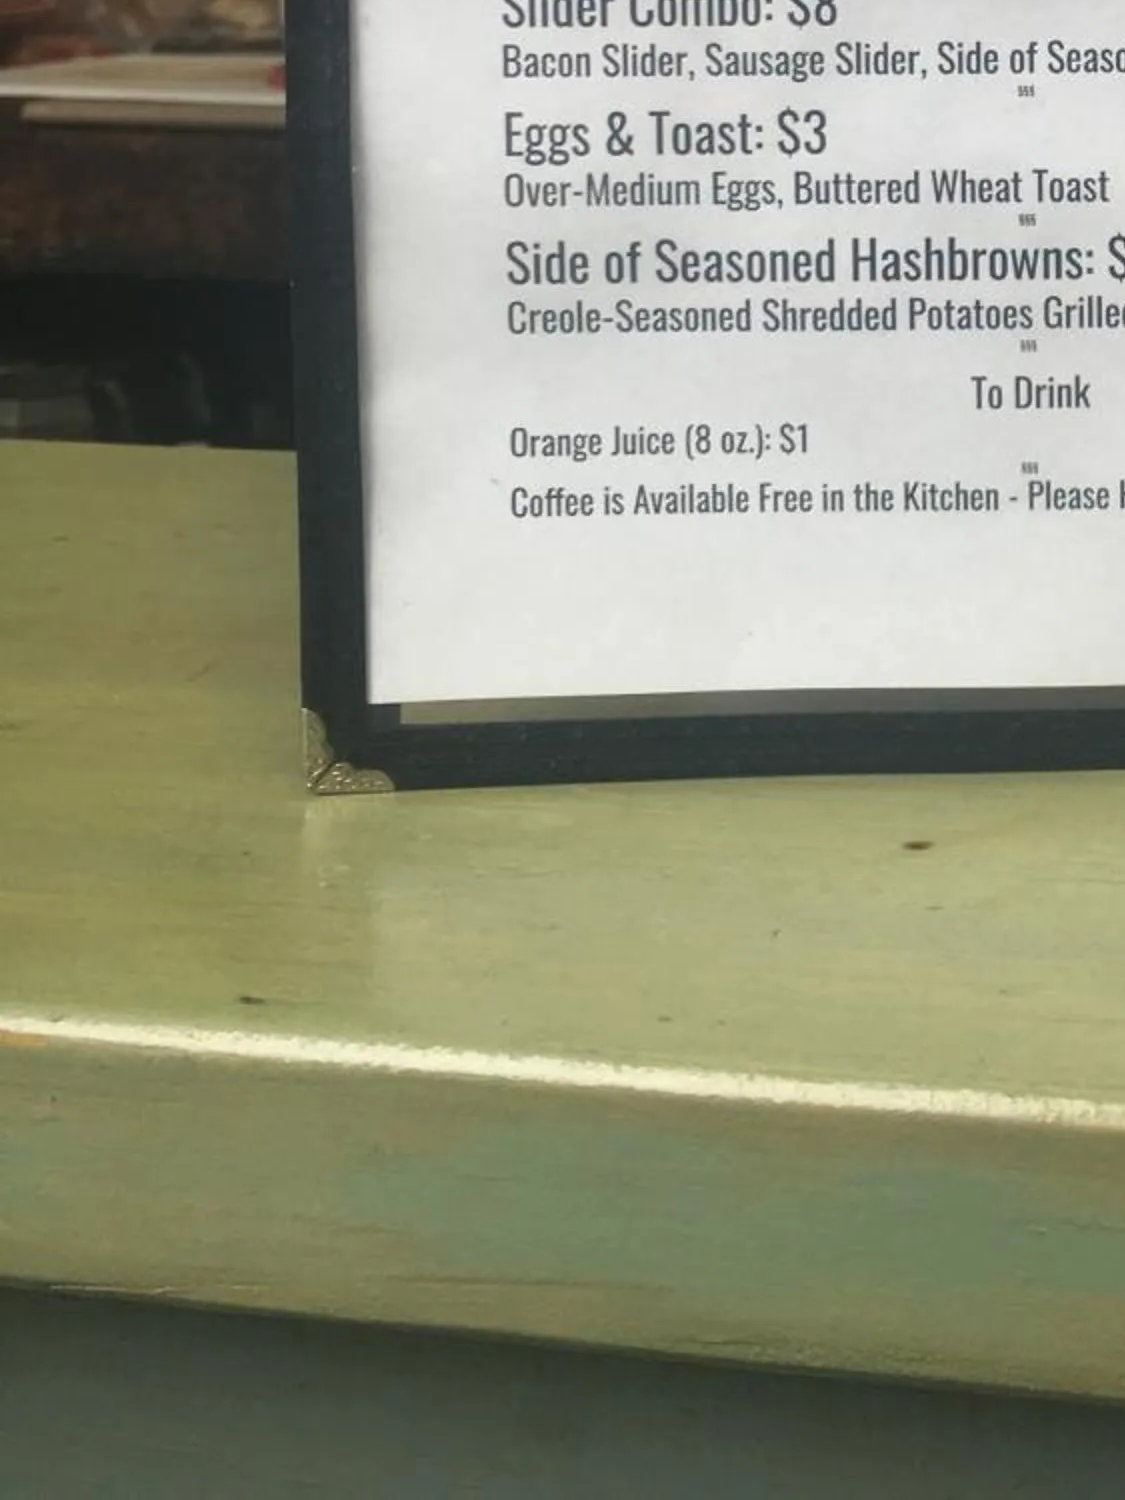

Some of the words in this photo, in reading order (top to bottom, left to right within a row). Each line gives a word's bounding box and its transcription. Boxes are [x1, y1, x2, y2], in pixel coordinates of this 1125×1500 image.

[501, 43, 592, 79] Bacon
[601, 42, 696, 82] Slider,
[704, 41, 825, 84] Sausage
[834, 40, 928, 80] Slider,
[936, 39, 1000, 76] Side
[1009, 40, 1039, 75] of
[504, 111, 592, 167] Eggs
[605, 110, 635, 157] &
[647, 109, 765, 157] Toast:
[776, 105, 827, 159] $3
[503, 171, 701, 209] Over-Medium
[711, 170, 784, 213] Eggs,
[793, 169, 921, 206] Buttered
[930, 168, 1024, 205] Wheat
[1031, 167, 1111, 204] Toast
[505, 239, 590, 286] Side
[604, 240, 643, 285] of
[654, 236, 836, 284] Seasoned
[851, 235, 1095, 283] Hashbrowns:
[507, 297, 752, 336] Creole-Seasoned
[761, 296, 898, 333] Shredded
[907, 296, 1034, 332] Potatoes
[969, 375, 1004, 411] To
[1013, 373, 1092, 410] Drink
[509, 426, 603, 463] Orange
[610, 424, 676, 457] Juice
[684, 423, 712, 462] (8
[720, 423, 772, 461] oz.):
[778, 422, 808, 456] $1
[510, 486, 595, 519] Coffee
[603, 485, 625, 516] is
[632, 482, 750, 516] Available
[758, 481, 814, 514] Free
[821, 483, 845, 513] in
[852, 481, 895, 513] the
[902, 480, 1000, 513] Kitchen
[1027, 479, 1111, 512] Please
